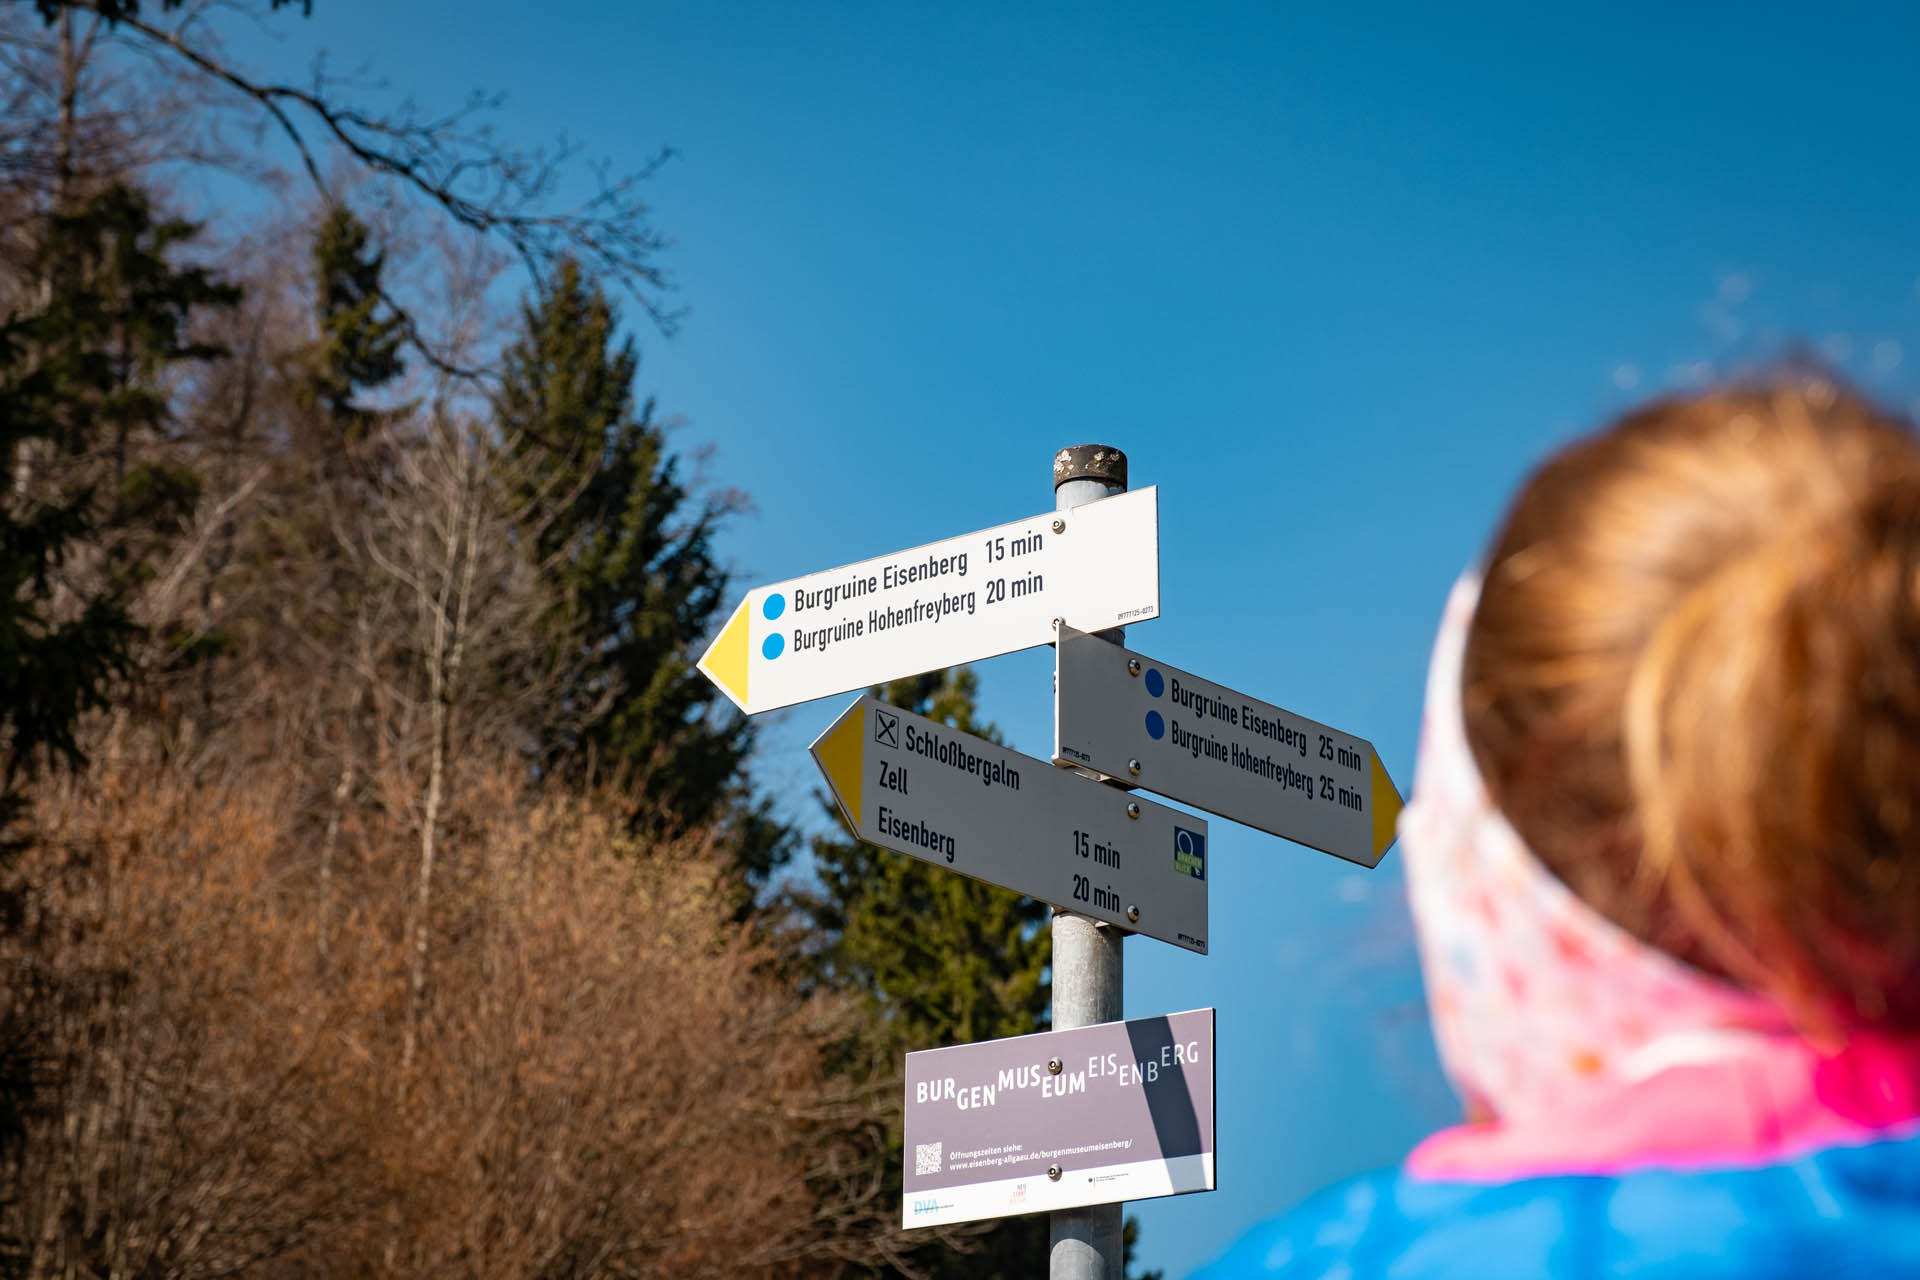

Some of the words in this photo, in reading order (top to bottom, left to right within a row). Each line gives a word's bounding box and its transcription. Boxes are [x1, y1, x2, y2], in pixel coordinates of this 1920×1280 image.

[794, 618, 863, 652] Burgruine
[869, 591, 976, 634] Hohenfreyberg
[986, 578, 1005, 605] 20
[1011, 571, 1043, 598] min
[795, 575, 877, 612] Burgruine
[883, 553, 967, 590] Eisenberg
[986, 537, 1005, 563] 15
[1011, 530, 1043, 557] min
[905, 725, 1020, 790] Schloßbergalm
[1171, 678, 1238, 725] Burgruine
[1242, 705, 1307, 757] Eisenberg
[1318, 734, 1333, 761] 25
[1337, 746, 1361, 772] min
[1171, 719, 1228, 763] Burgruine
[1231, 742, 1313, 800] Hohenfreyberg
[1319, 775, 1334, 802] 25
[1338, 786, 1362, 812] min
[879, 760, 908, 795] Zell
[1073, 830, 1089, 858] 15
[1094, 842, 1120, 870] min
[878, 806, 955, 863] Eisenberg
[1073, 874, 1089, 902] 20
[1094, 885, 1120, 913] min
[949, 1146, 1002, 1161] Öffnungszeiten
